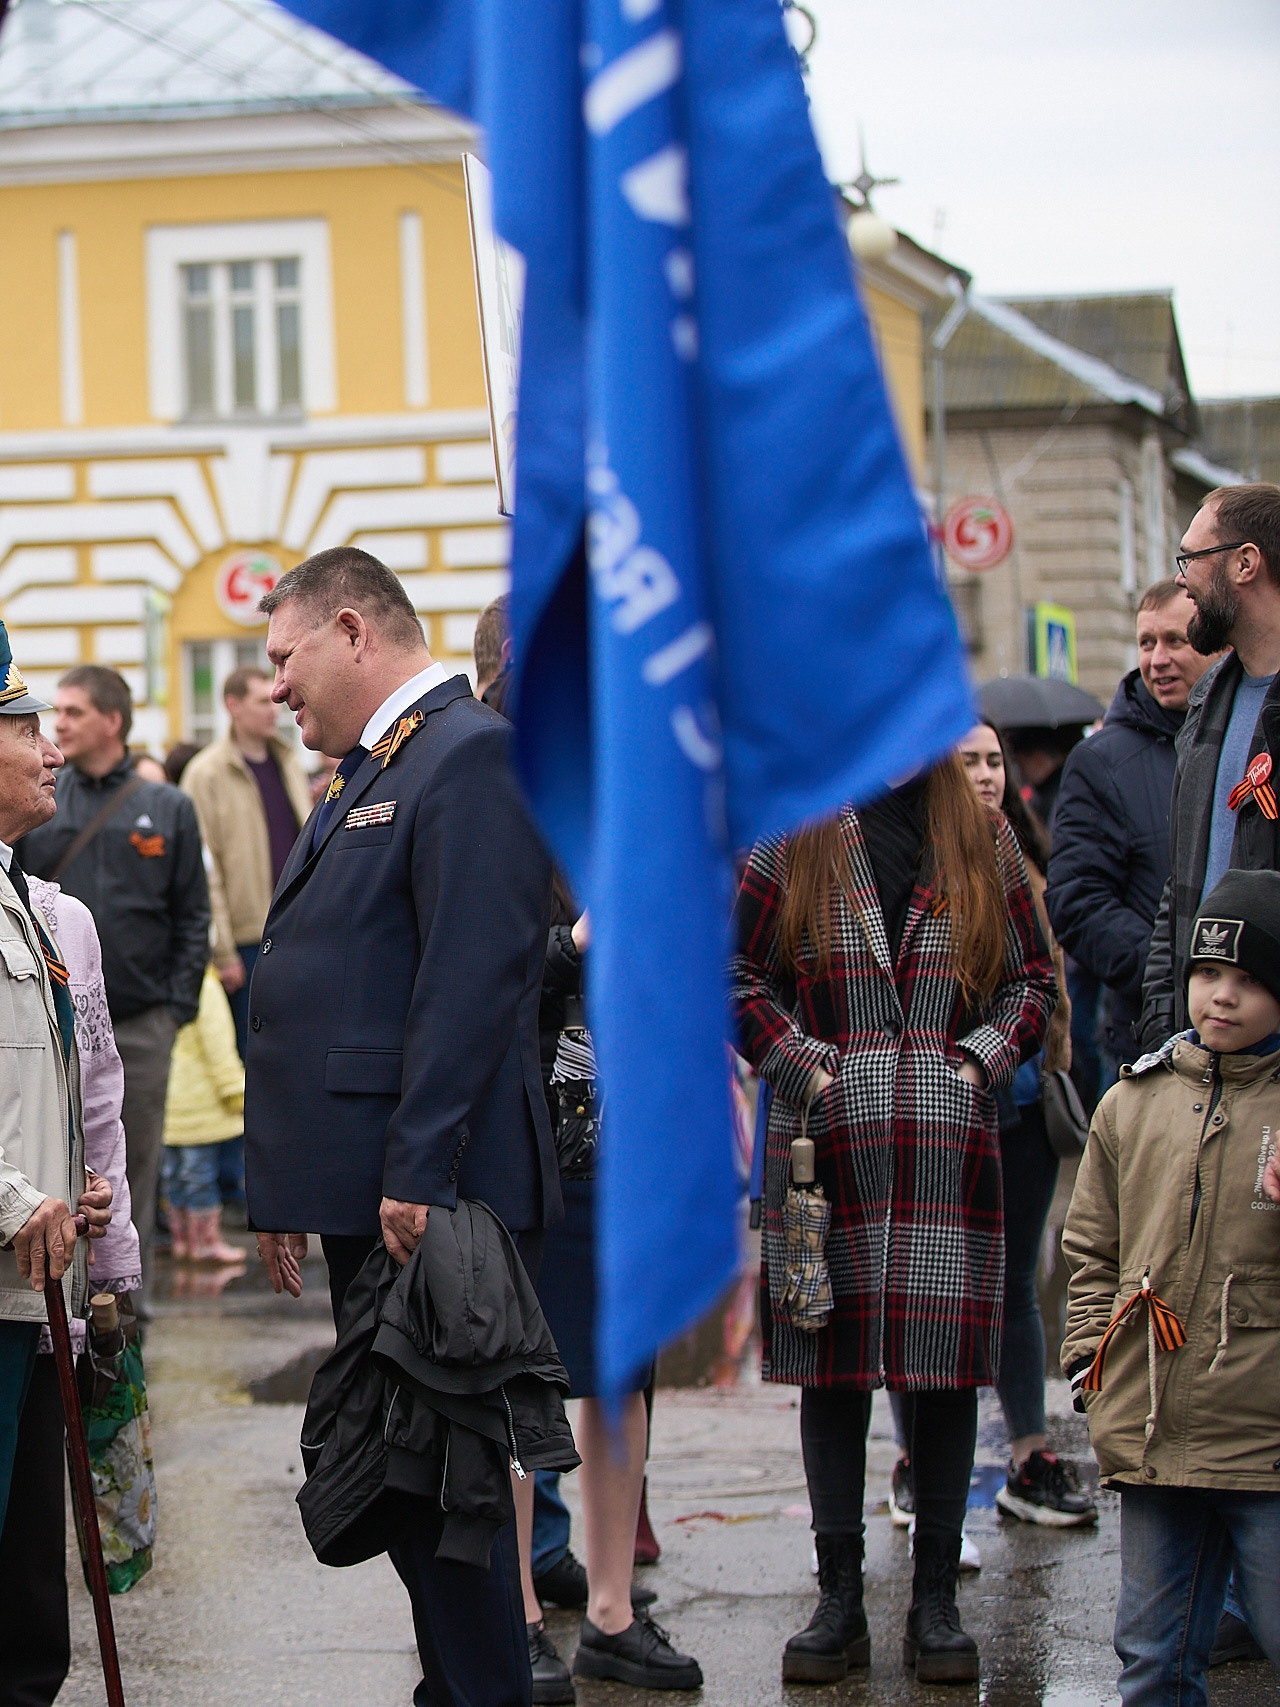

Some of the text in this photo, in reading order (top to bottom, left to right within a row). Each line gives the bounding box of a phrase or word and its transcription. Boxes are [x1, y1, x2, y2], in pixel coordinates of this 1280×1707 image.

[1199, 946, 1226, 956] adidas
[1262, 1135, 1270, 1145] up
[1258, 1145, 1267, 1163] Give
